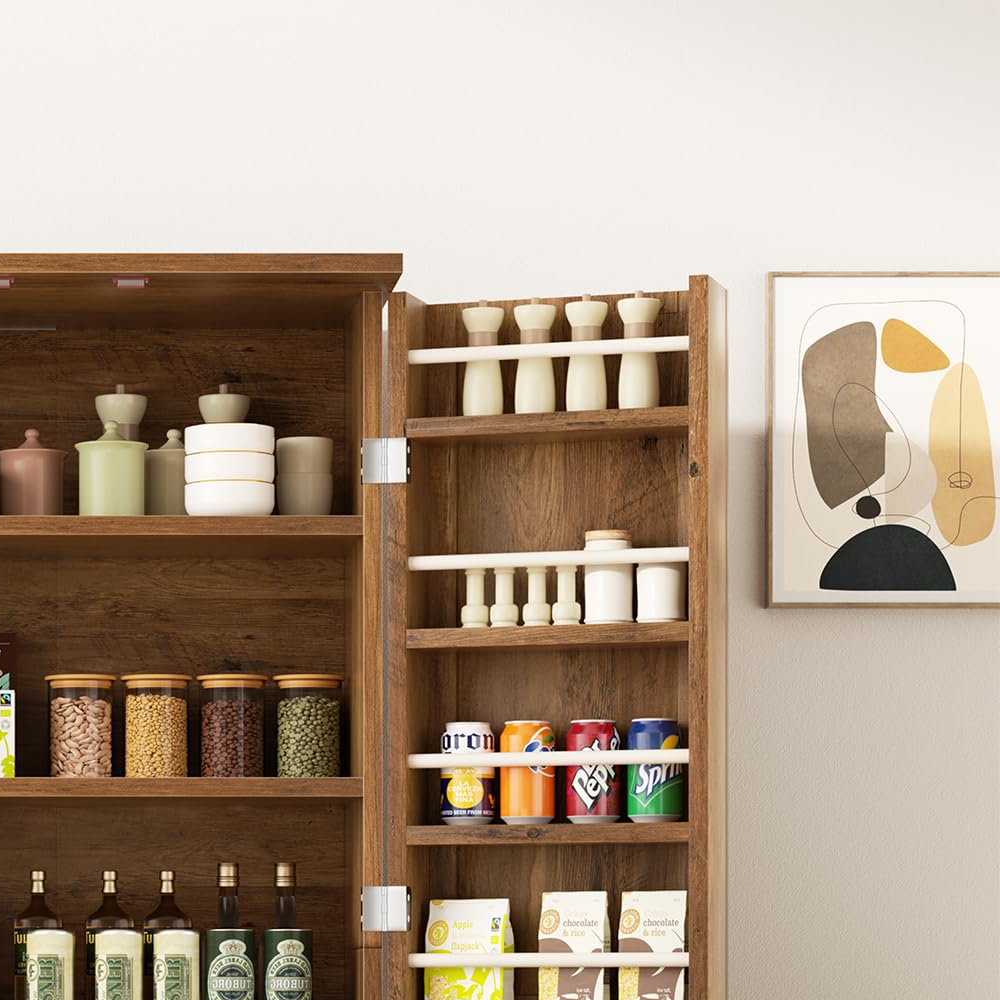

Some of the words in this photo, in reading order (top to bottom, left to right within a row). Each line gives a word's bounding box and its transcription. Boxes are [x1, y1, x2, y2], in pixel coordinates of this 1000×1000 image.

[452, 920, 473, 929] Apple
[563, 919, 599, 927] chocolate
[643, 918, 679, 927] chocolate
[571, 929, 586, 937] rice
[651, 929, 666, 937] rice
